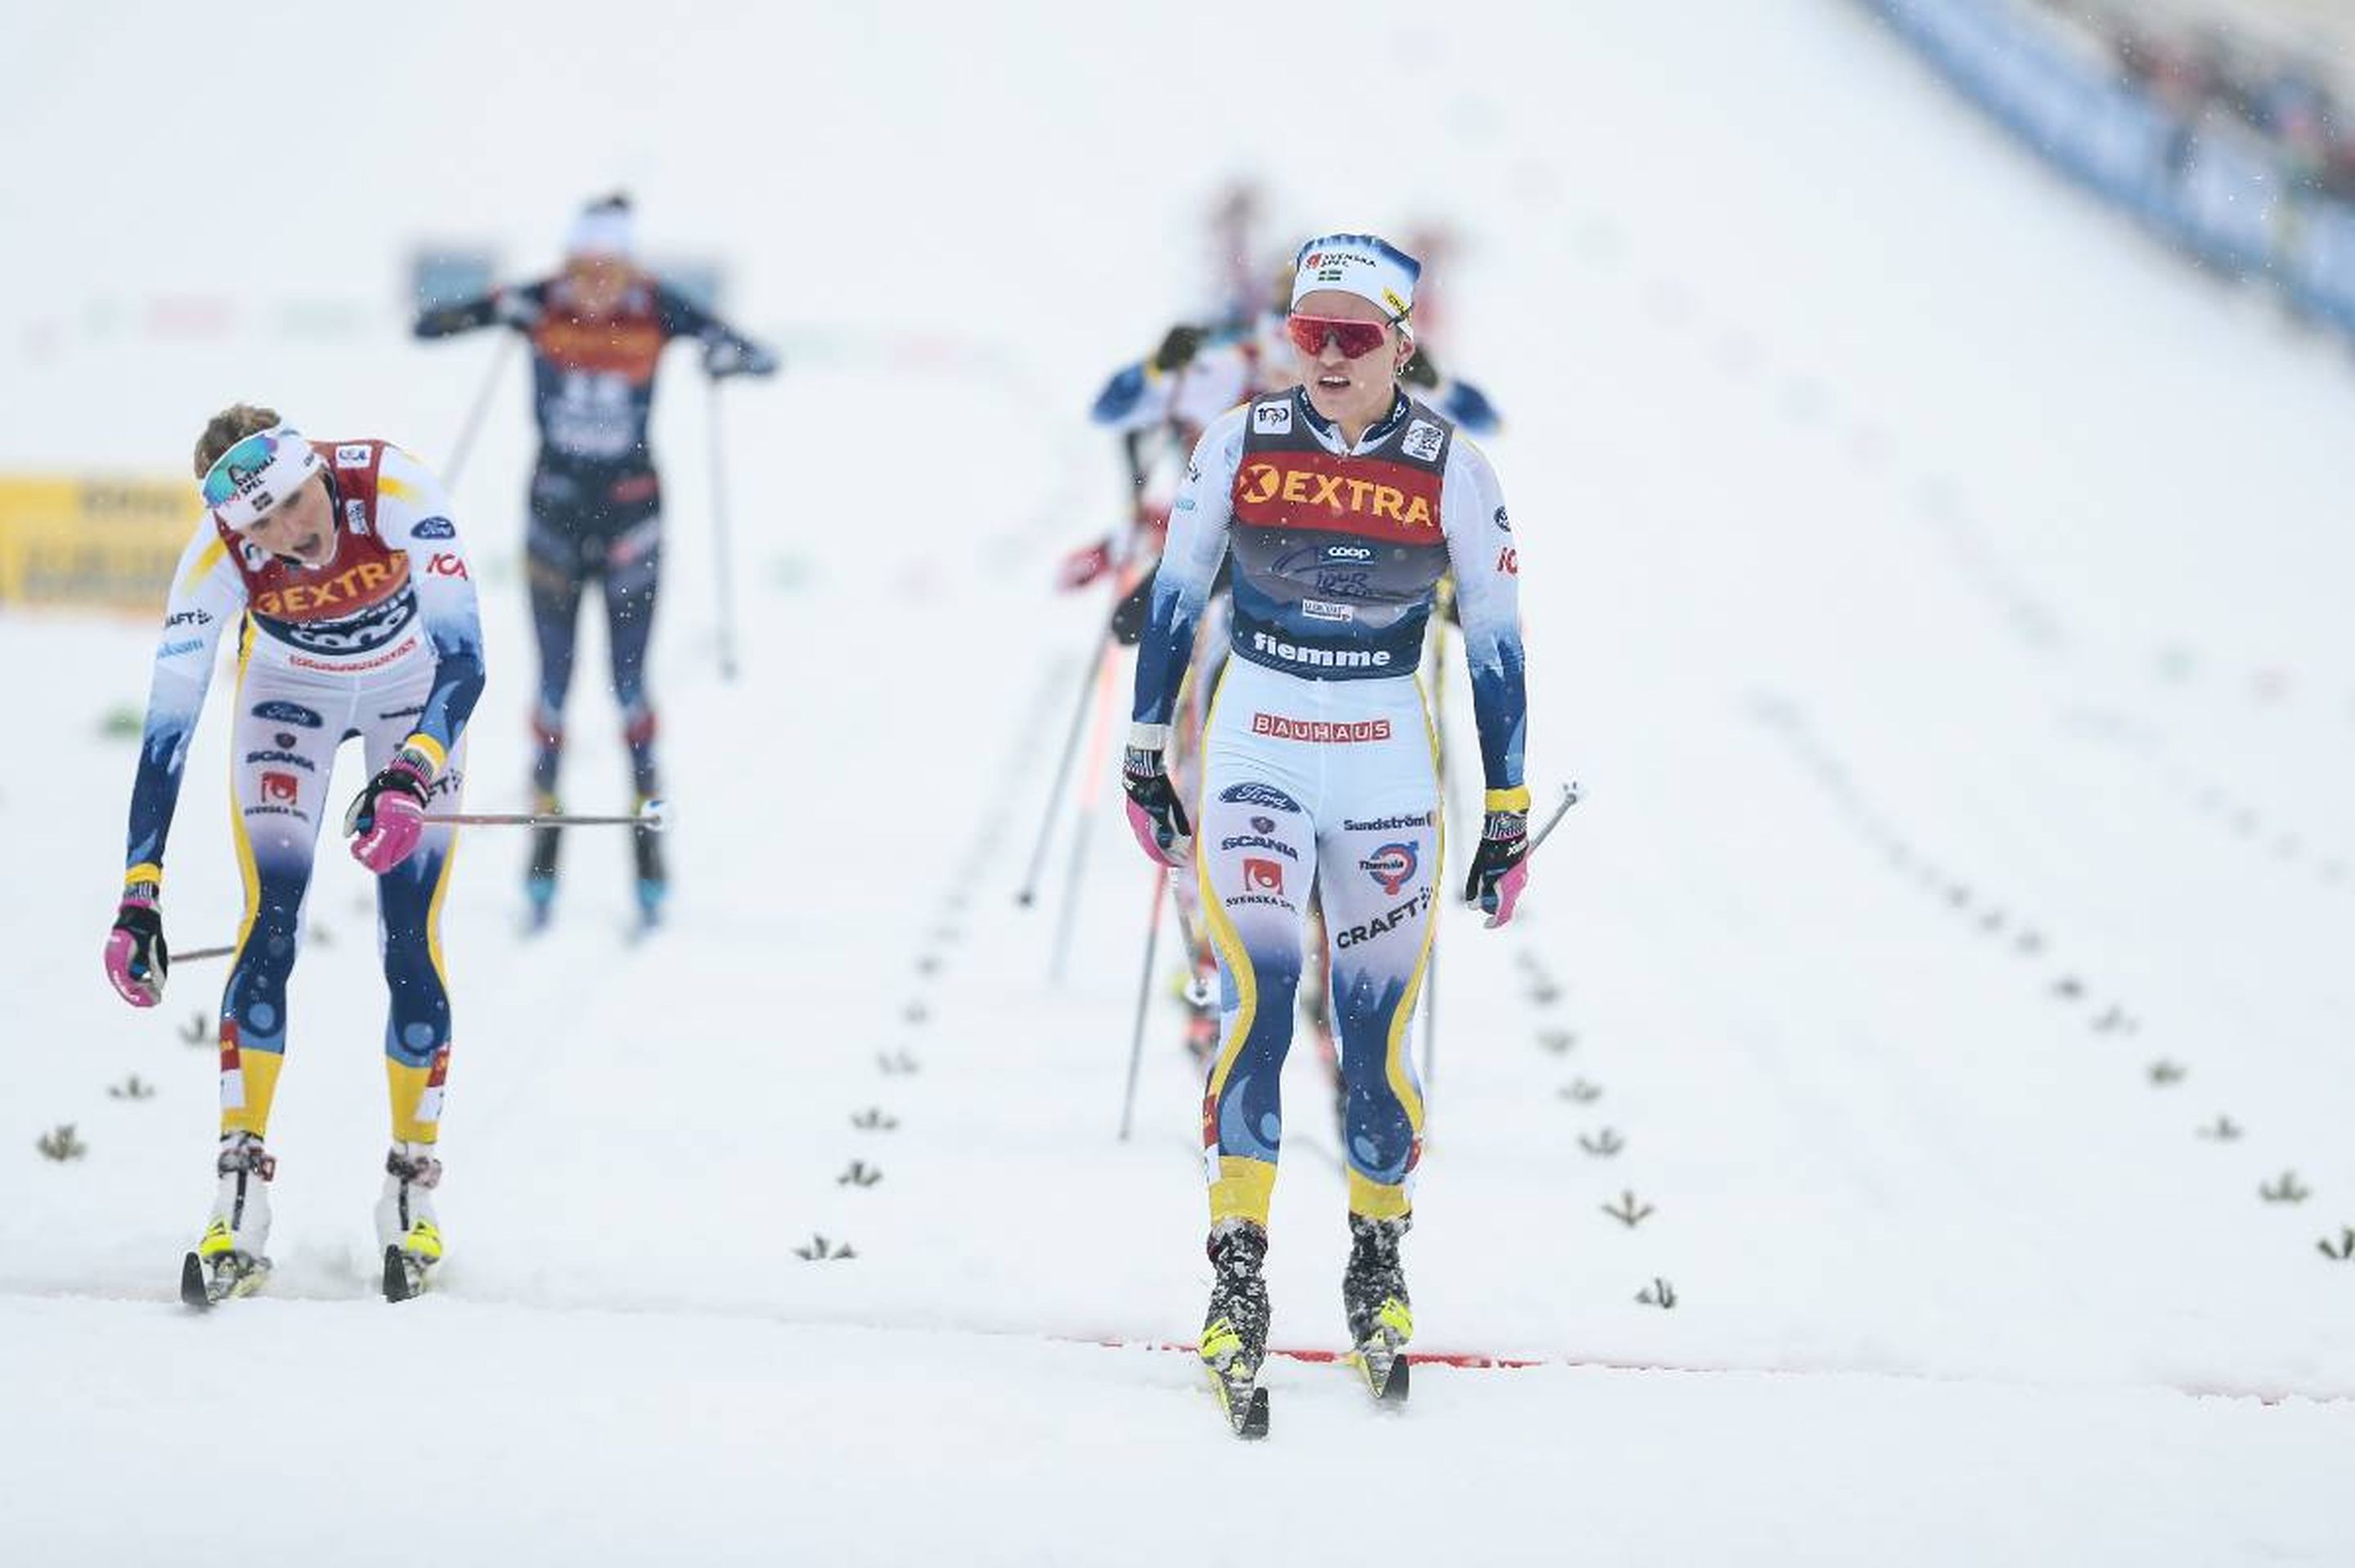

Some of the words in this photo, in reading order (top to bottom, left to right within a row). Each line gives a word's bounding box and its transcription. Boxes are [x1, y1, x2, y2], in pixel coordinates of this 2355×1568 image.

[1282, 470, 1433, 526] EXTRA
[1328, 546, 1370, 559] coop
[426, 553, 469, 581] ICA
[1254, 631, 1391, 667] fiemme
[1254, 715, 1390, 741] BAUHAUS
[1236, 785, 1288, 808] Ford
[1343, 813, 1425, 831] Sundström
[1221, 835, 1299, 861] SCANIA
[1226, 894, 1278, 907] SVENSKA
[1336, 897, 1419, 949] CRAFT
